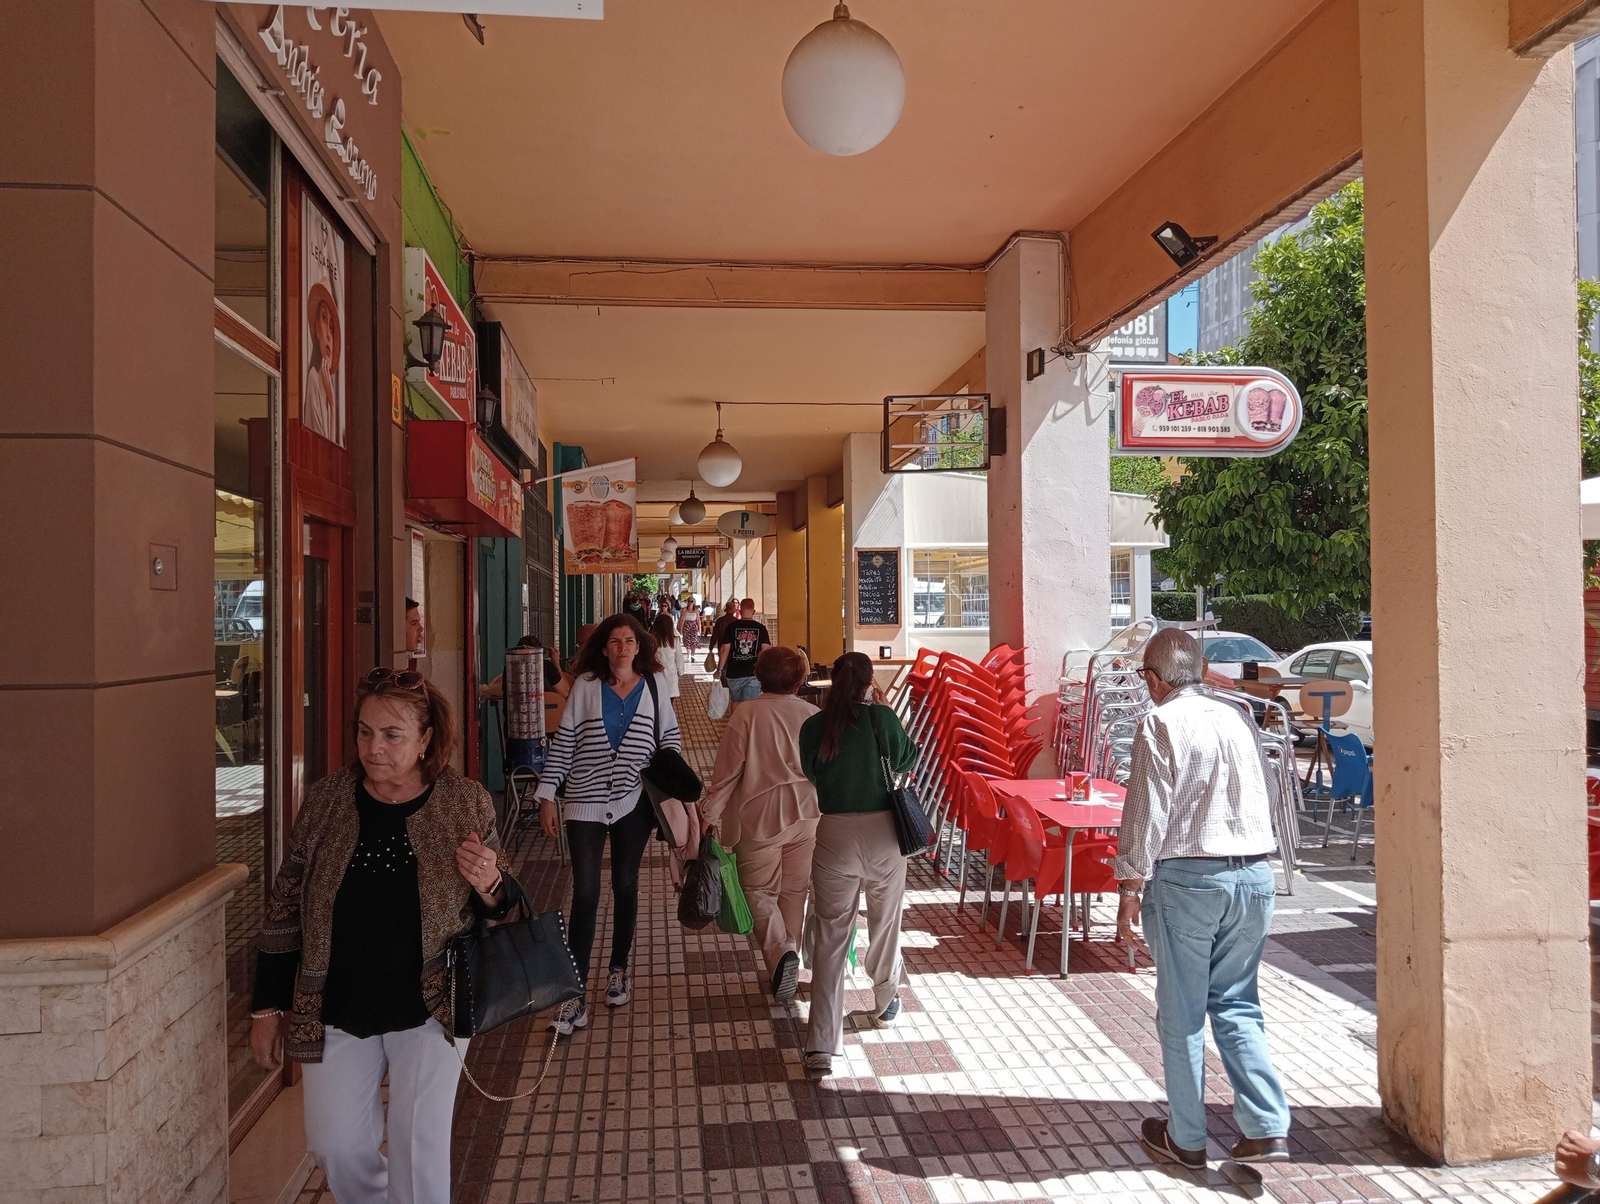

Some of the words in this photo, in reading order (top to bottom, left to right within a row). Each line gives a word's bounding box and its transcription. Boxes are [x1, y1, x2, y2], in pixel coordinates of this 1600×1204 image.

[258, 4, 325, 119] Andrés
[325, 98, 377, 200] Lozano
[311, 241, 338, 281] LECARRÉ
[1135, 337, 1159, 346] global
[440, 339, 466, 384] KEBAB
[1170, 390, 1187, 403] EL
[1168, 395, 1229, 421] KEBAB
[1190, 415, 1211, 423] PABLO
[741, 512, 749, 529] P
